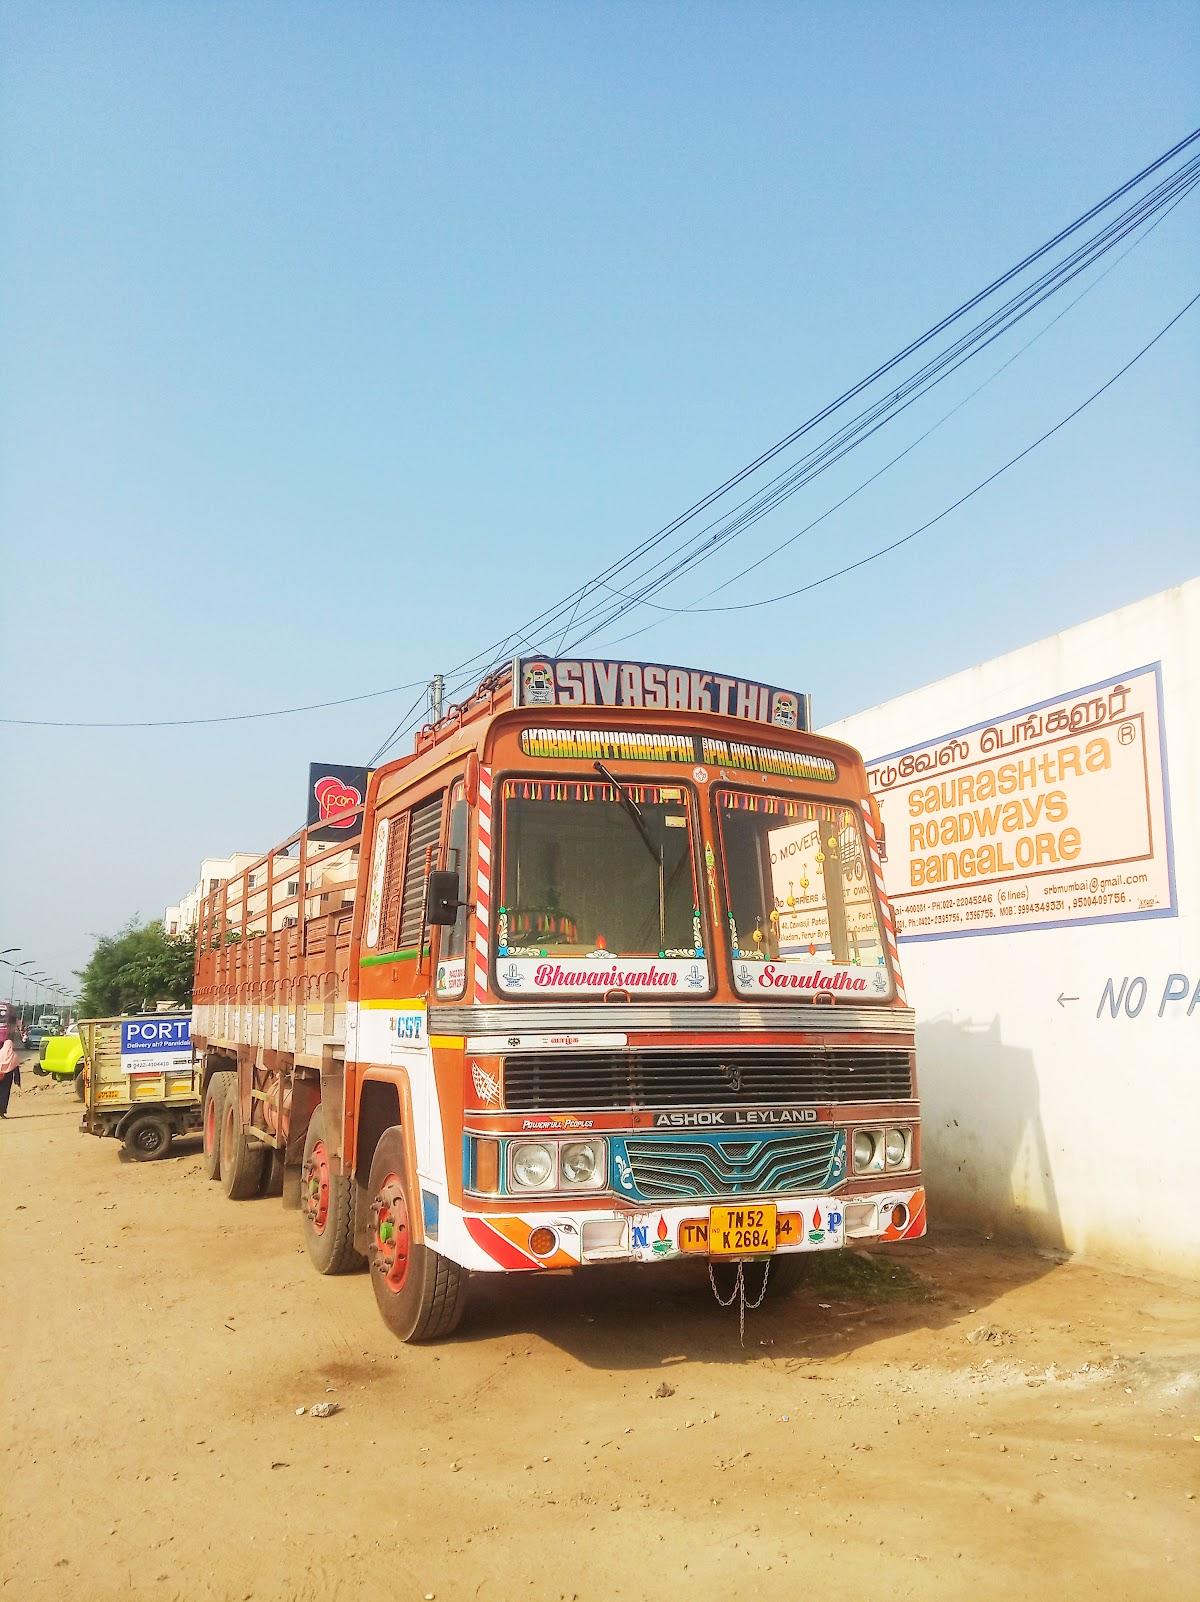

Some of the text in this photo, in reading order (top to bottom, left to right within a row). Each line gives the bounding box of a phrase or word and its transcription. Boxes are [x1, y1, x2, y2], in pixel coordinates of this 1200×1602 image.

[556, 661, 769, 721] SIVASAKTHI
[534, 963, 679, 989] Bhavanisankar
[758, 965, 868, 991] Sarulatha
[1096, 976, 1148, 1019] NO
[127, 1021, 192, 1041] PORT
[657, 1109, 818, 1127] ASHOK LEYLAND
[728, 1210, 765, 1228] TN 52
[827, 1211, 843, 1233] P
[631, 1225, 650, 1249] N
[723, 1231, 770, 1249] K 2684
